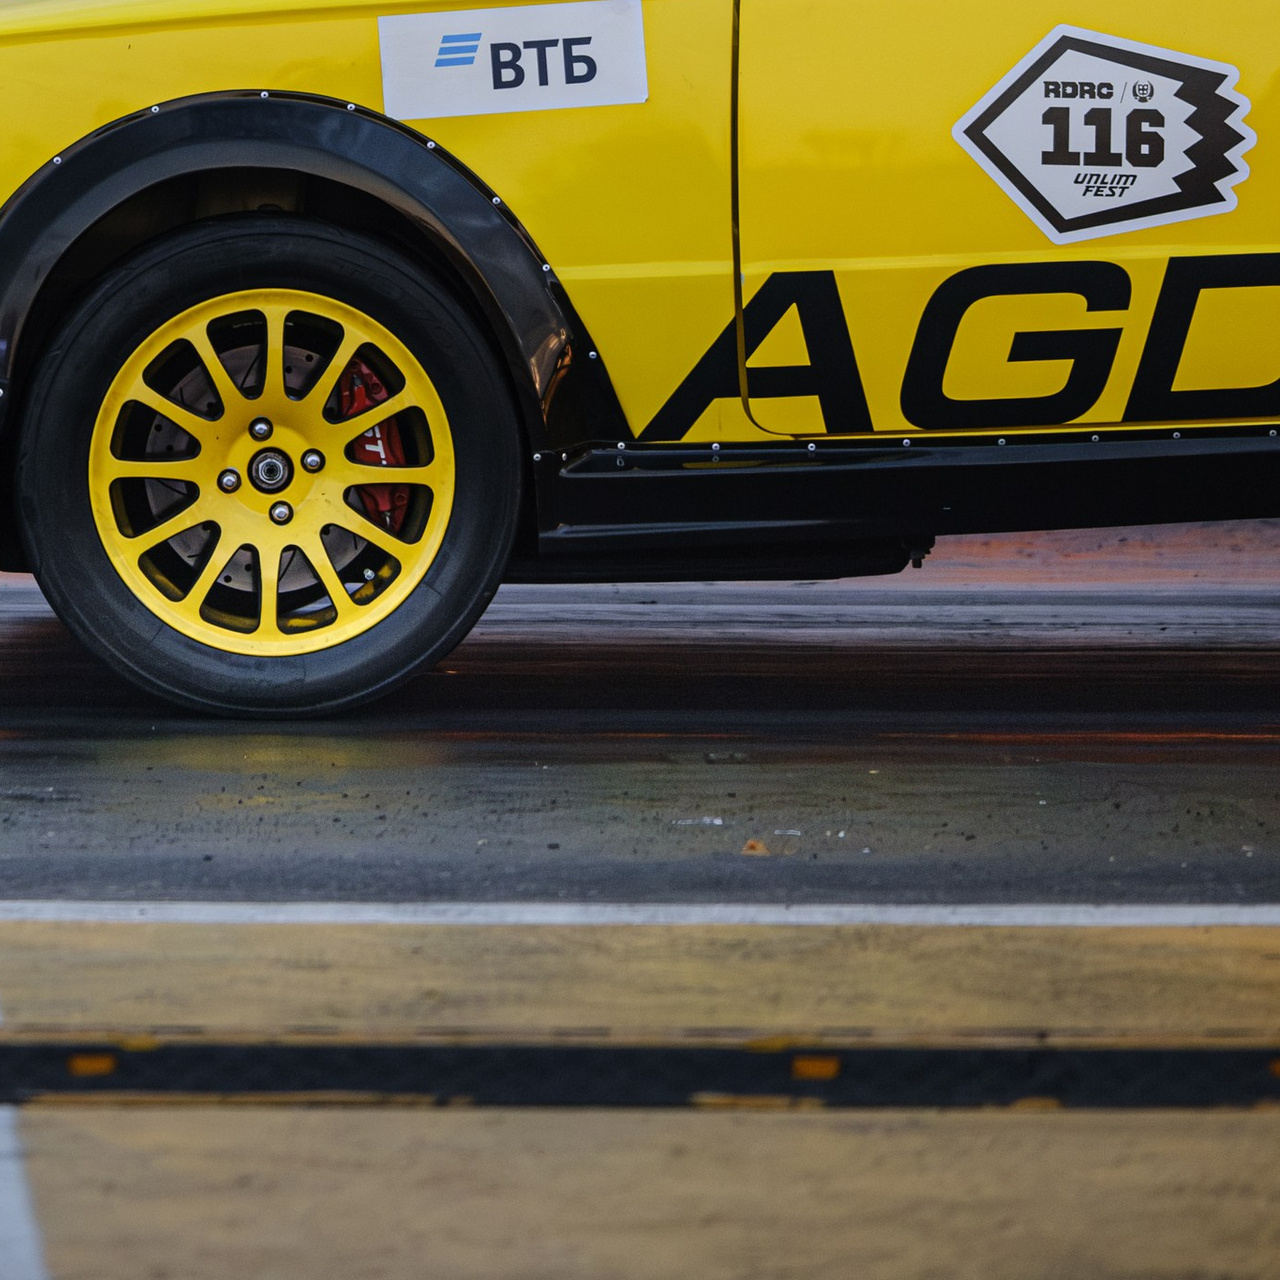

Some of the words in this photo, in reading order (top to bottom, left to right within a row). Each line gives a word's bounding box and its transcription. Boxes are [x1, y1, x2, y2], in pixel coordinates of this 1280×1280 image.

[490, 36, 597, 90] ВТБ
[1043, 81, 1114, 99] RDRC
[1041, 106, 1165, 168] 116
[1082, 185, 1129, 197] FEST
